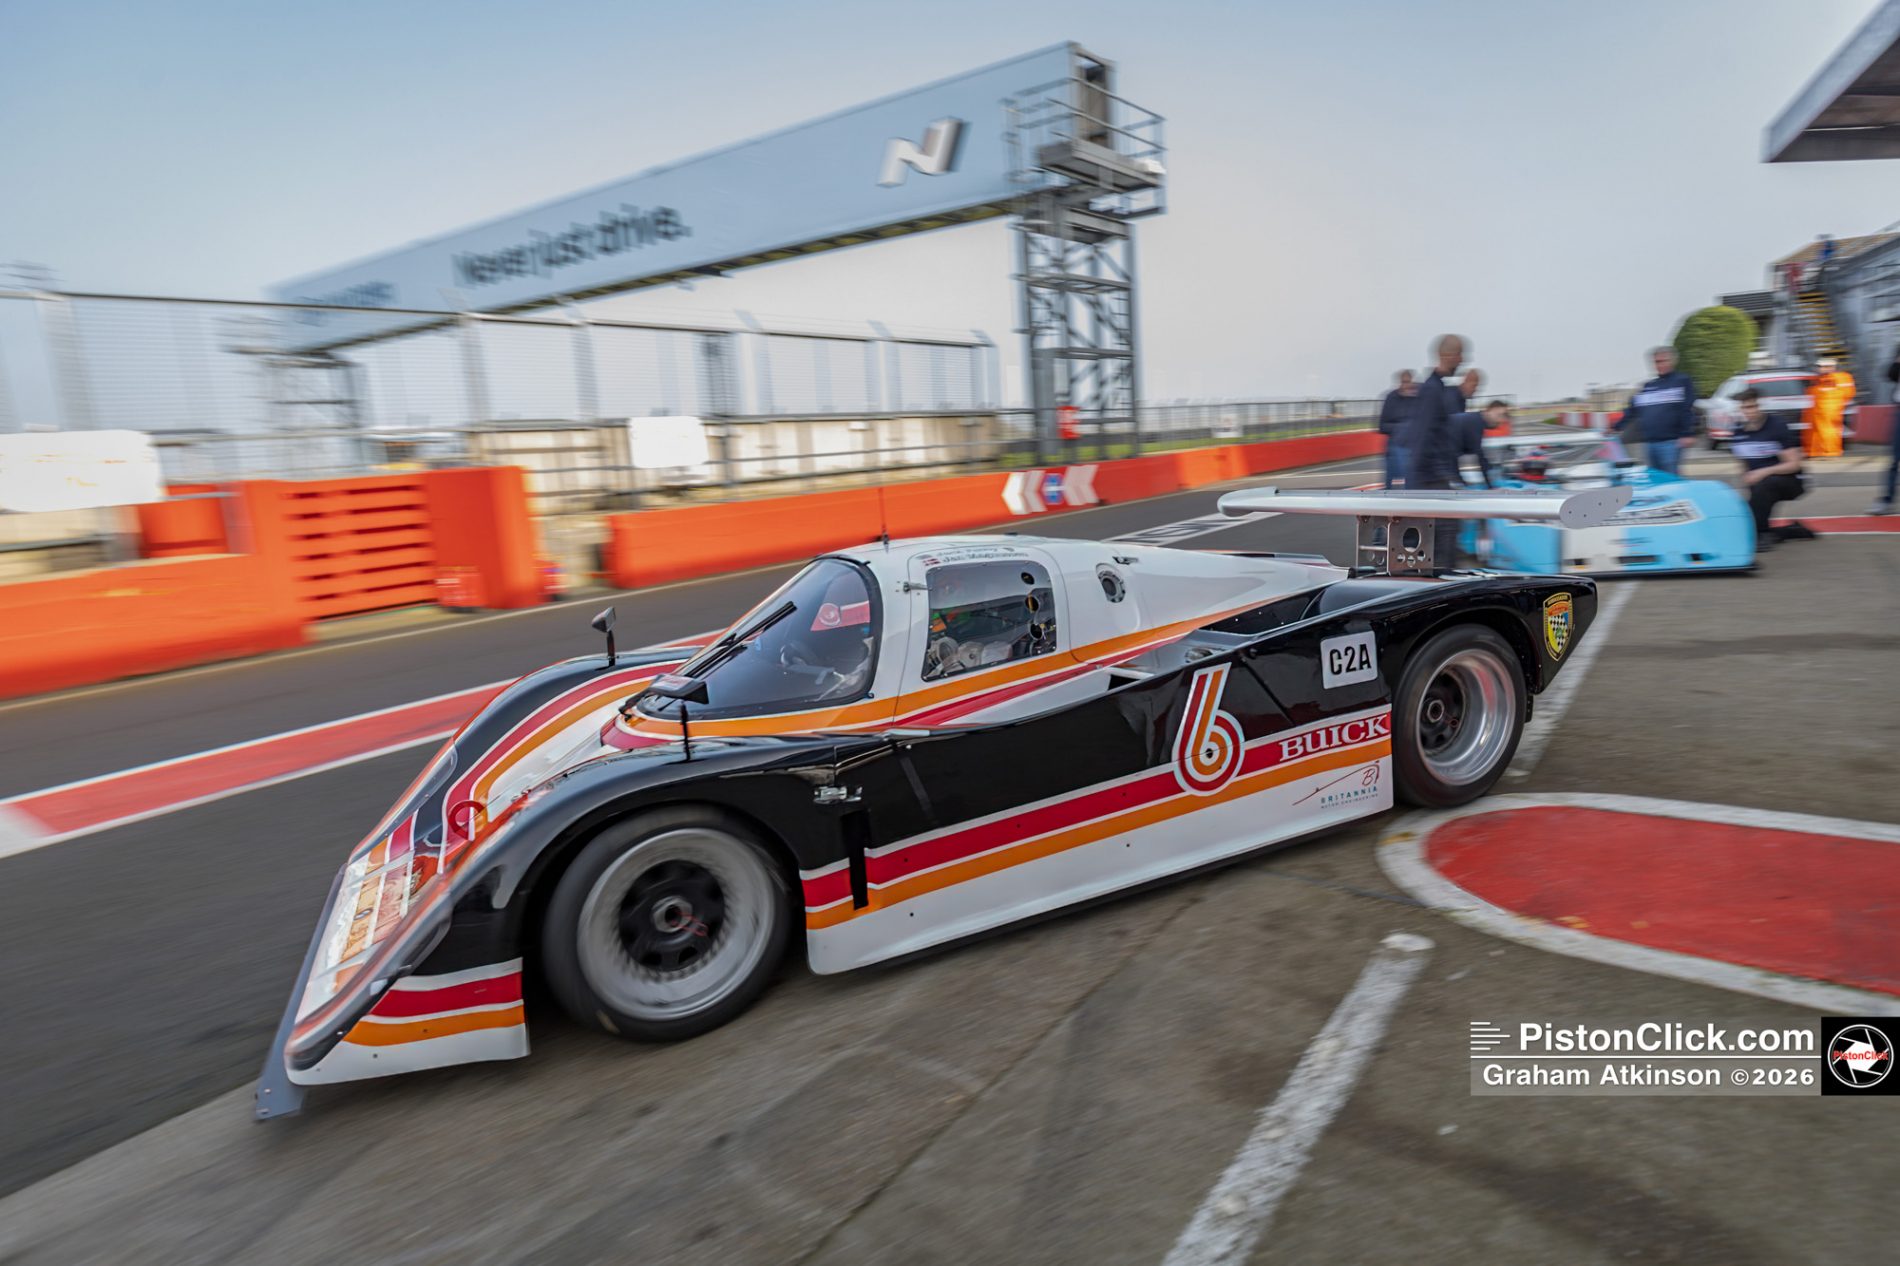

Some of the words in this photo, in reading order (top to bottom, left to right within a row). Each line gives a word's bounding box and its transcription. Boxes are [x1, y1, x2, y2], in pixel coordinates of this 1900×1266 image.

[1329, 643, 1372, 676] C2A
[1172, 661, 1246, 796] 6
[1279, 714, 1389, 762] BUICK
[1321, 786, 1377, 803] BRITANNIA
